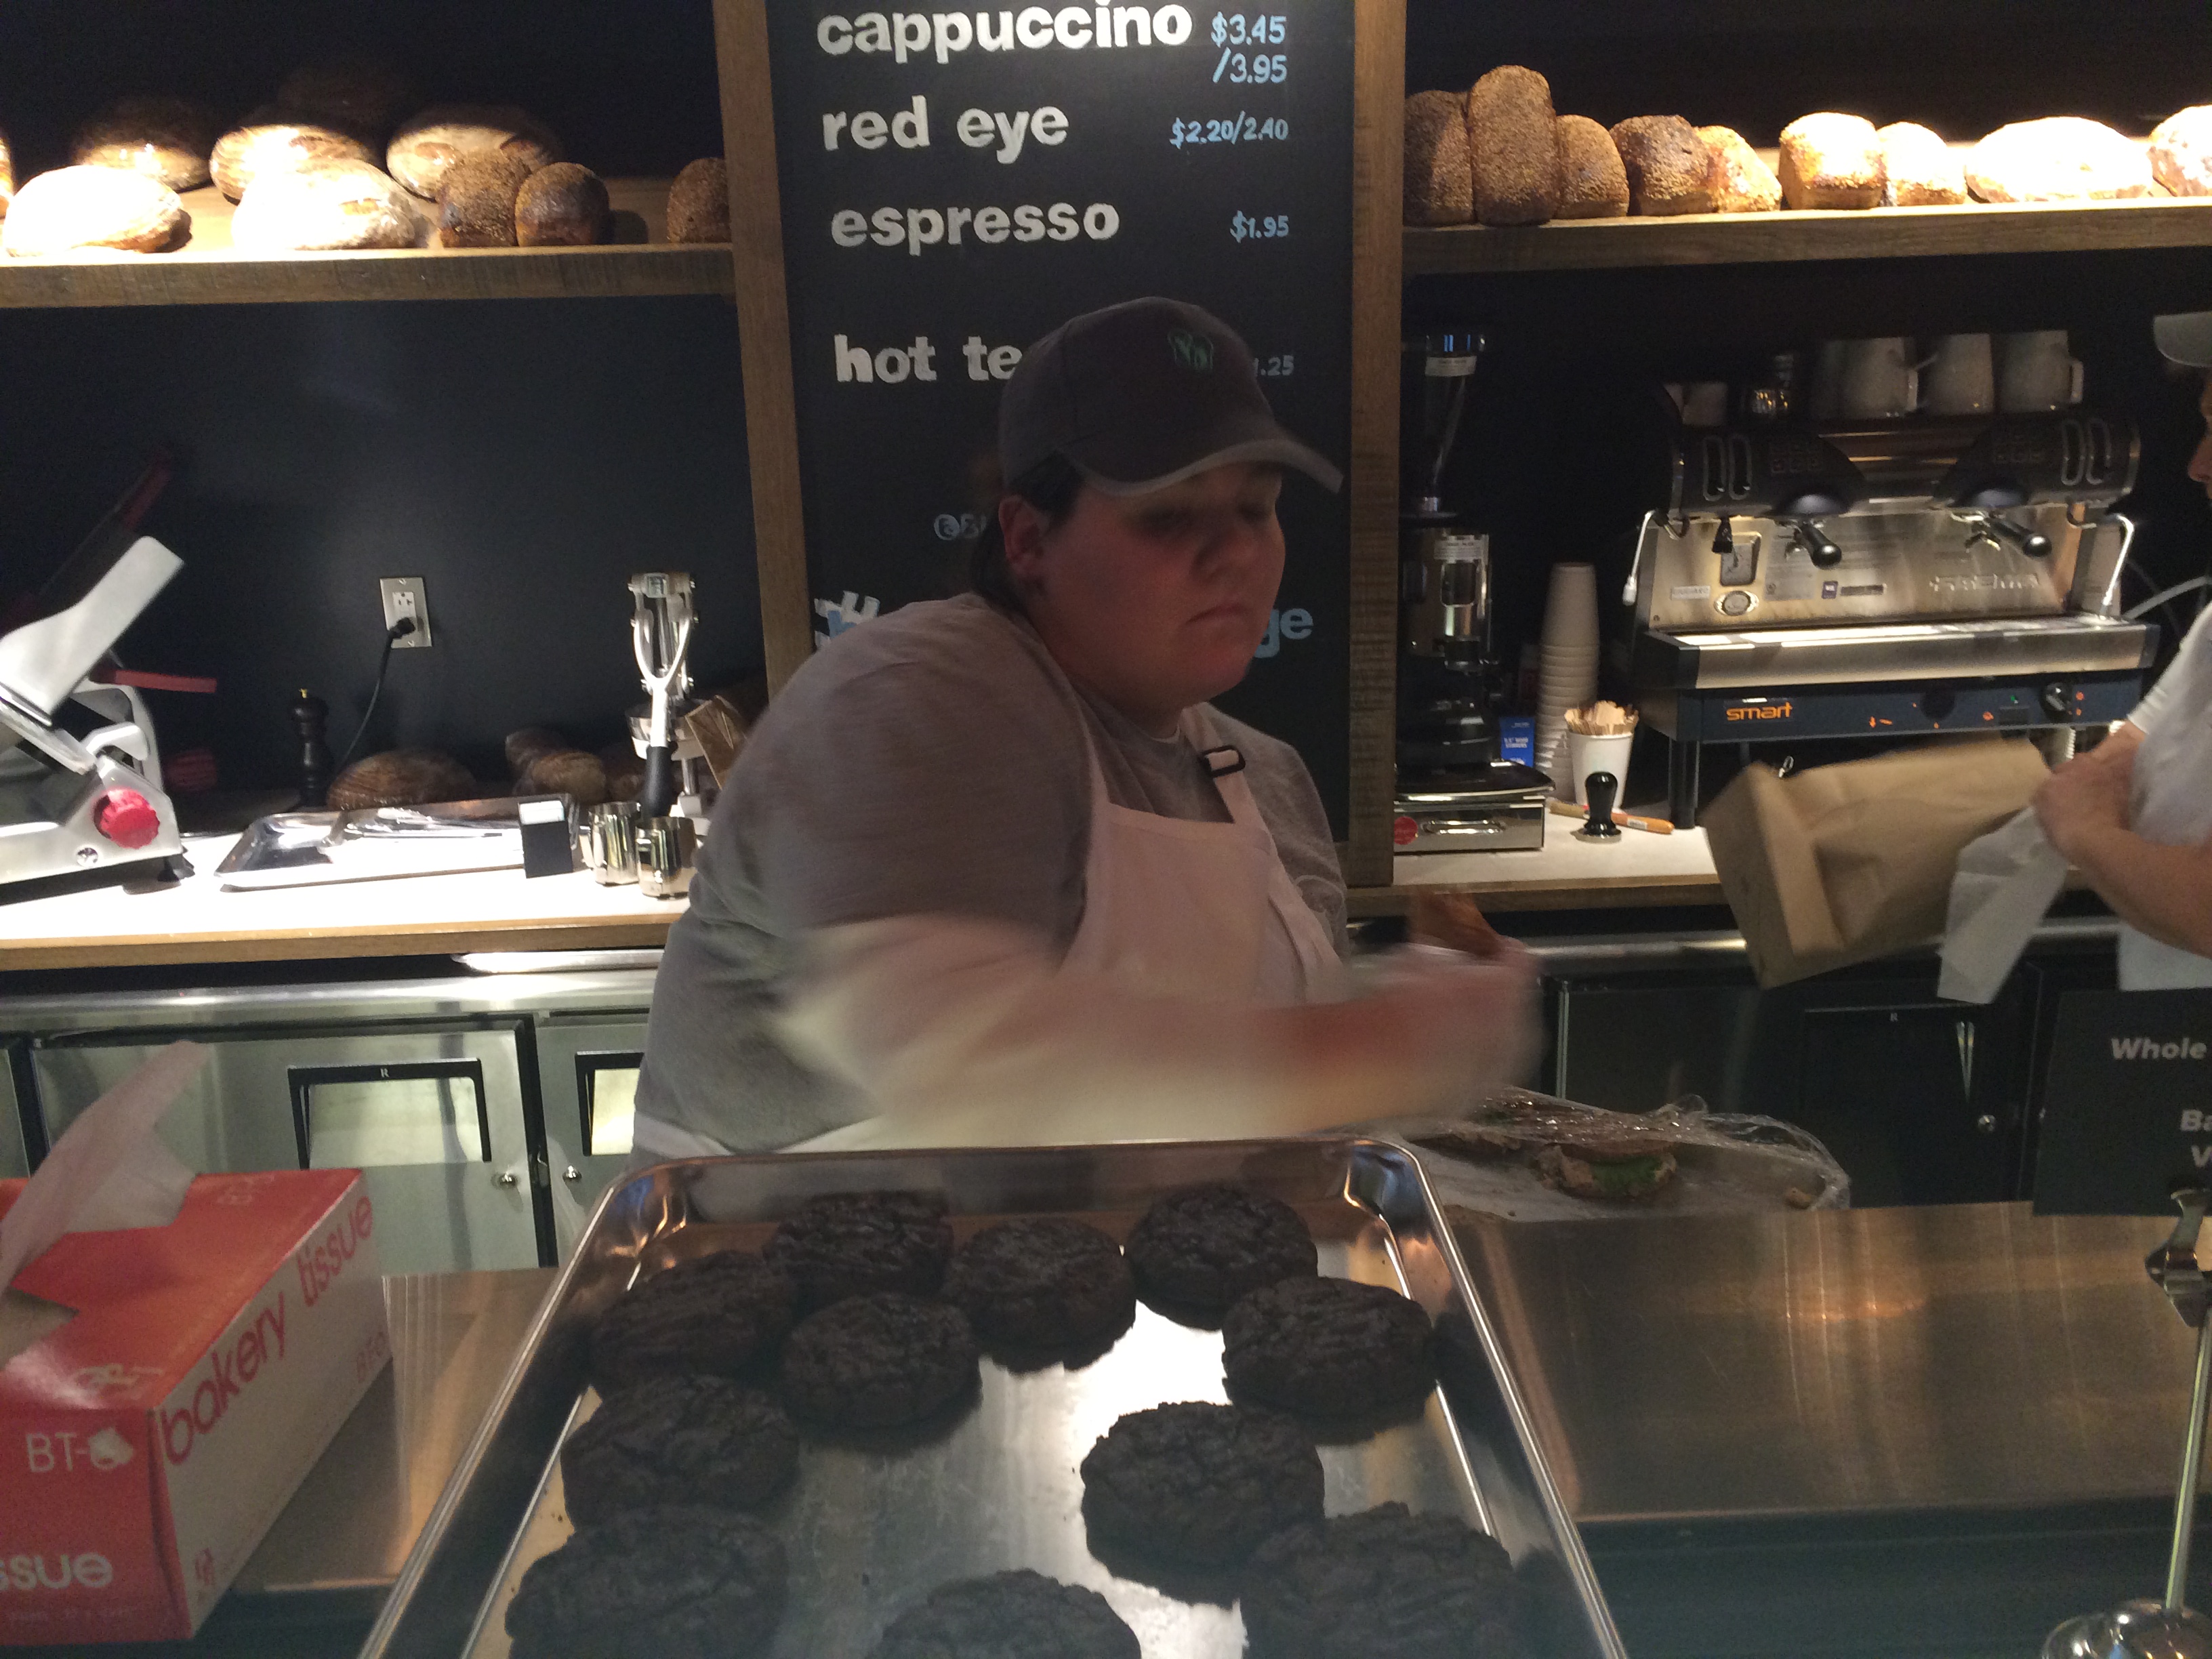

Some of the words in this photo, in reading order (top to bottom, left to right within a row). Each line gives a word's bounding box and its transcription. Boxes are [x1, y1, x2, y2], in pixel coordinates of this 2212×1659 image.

[817, 0, 1193, 64] cappuccino
[1210, 12, 1287, 47] $3.45
[1211, 49, 1288, 84] /3.95
[822, 95, 930, 151] red
[956, 106, 1069, 164] eye
[1169, 111, 1289, 148] $2.20/2.40
[831, 203, 1120, 256] espresso
[1230, 211, 1290, 243] $1.95
[834, 333, 937, 384] hot
[962, 335, 1023, 382] te
[1254, 607, 1314, 659] ge
[1725, 701, 1793, 722] smart
[2110, 1037, 2207, 1061] Whole
[161, 1292, 286, 1465] bakery
[297, 1195, 373, 1307] tissue
